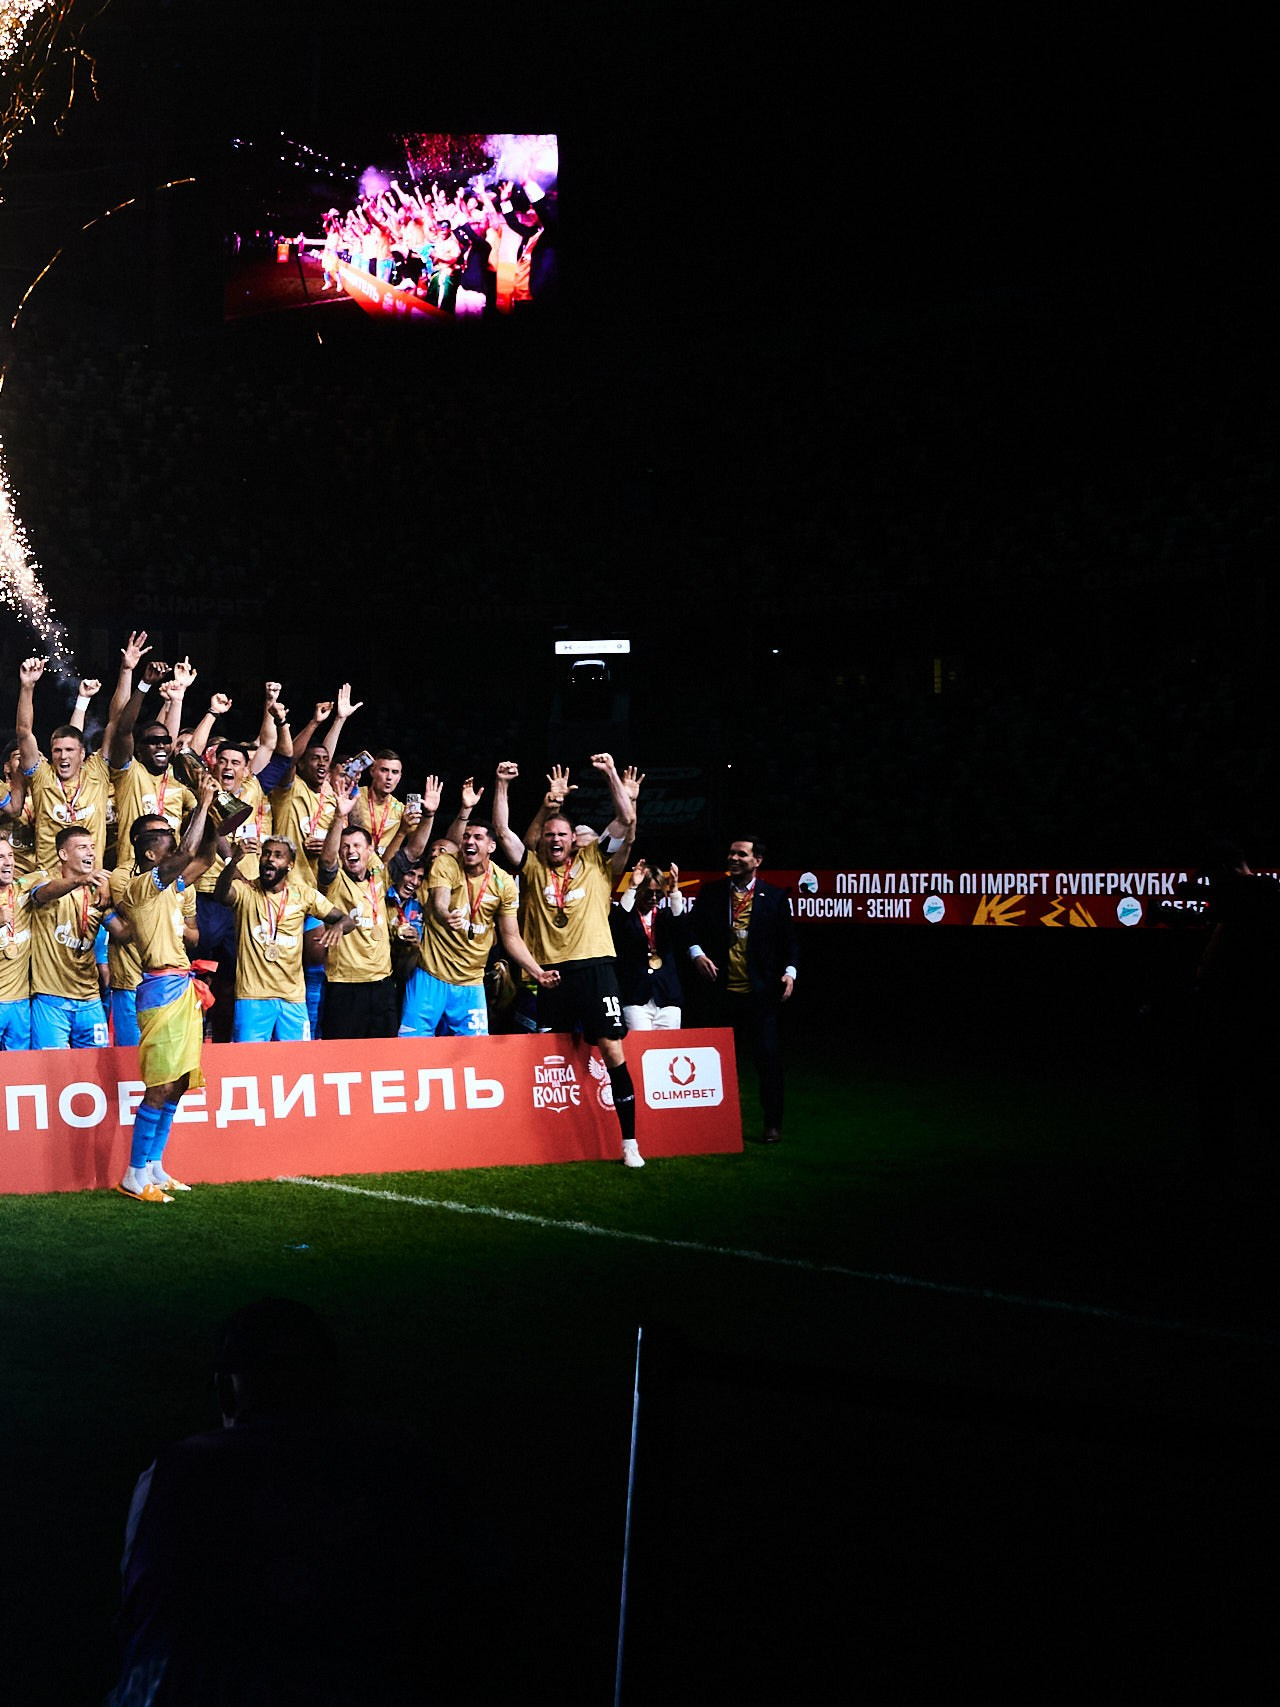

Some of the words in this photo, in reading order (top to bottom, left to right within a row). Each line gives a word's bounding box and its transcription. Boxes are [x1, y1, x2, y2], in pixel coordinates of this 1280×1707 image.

[797, 898, 853, 917] РОССИИ
[867, 899, 912, 918] ЗЕНИТ
[534, 1064, 577, 1083] БИТВА
[5, 1066, 505, 1131] ПОБЕДИТЕЛЬ
[532, 1084, 581, 1108] ВОЛГЕ
[652, 1088, 716, 1101] OLIMPBET
